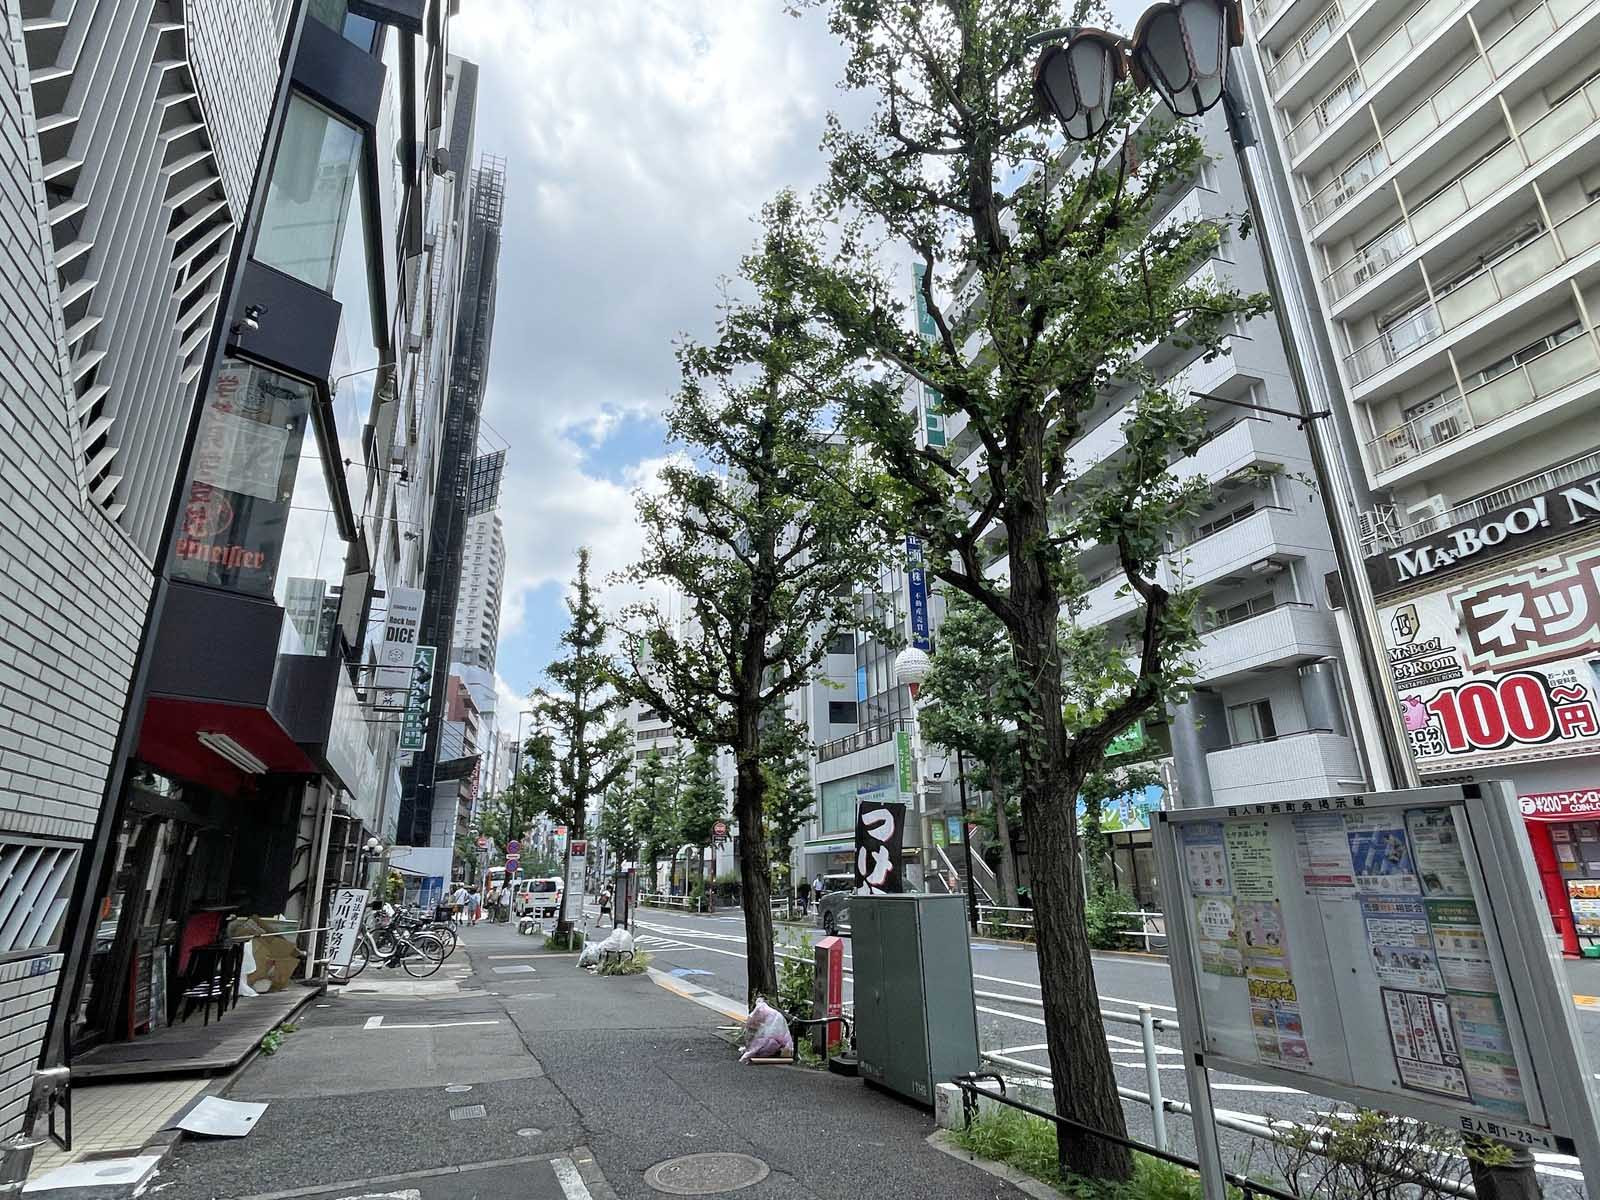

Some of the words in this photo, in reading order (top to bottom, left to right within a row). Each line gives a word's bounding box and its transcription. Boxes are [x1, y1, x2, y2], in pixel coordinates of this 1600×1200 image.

[1471, 564, 1600, 647] ネッ
[386, 627, 415, 643] DICE
[1413, 655, 1458, 678] Room
[1429, 676, 1552, 749] 100
[1227, 796, 1366, 817] 百人町西町会掲示板
[1560, 791, 1600, 805] コインロ
[328, 890, 354, 961] 今川事務所
[350, 894, 364, 929] 司法書士
[1460, 1117, 1550, 1148] 百人町1-23-4
